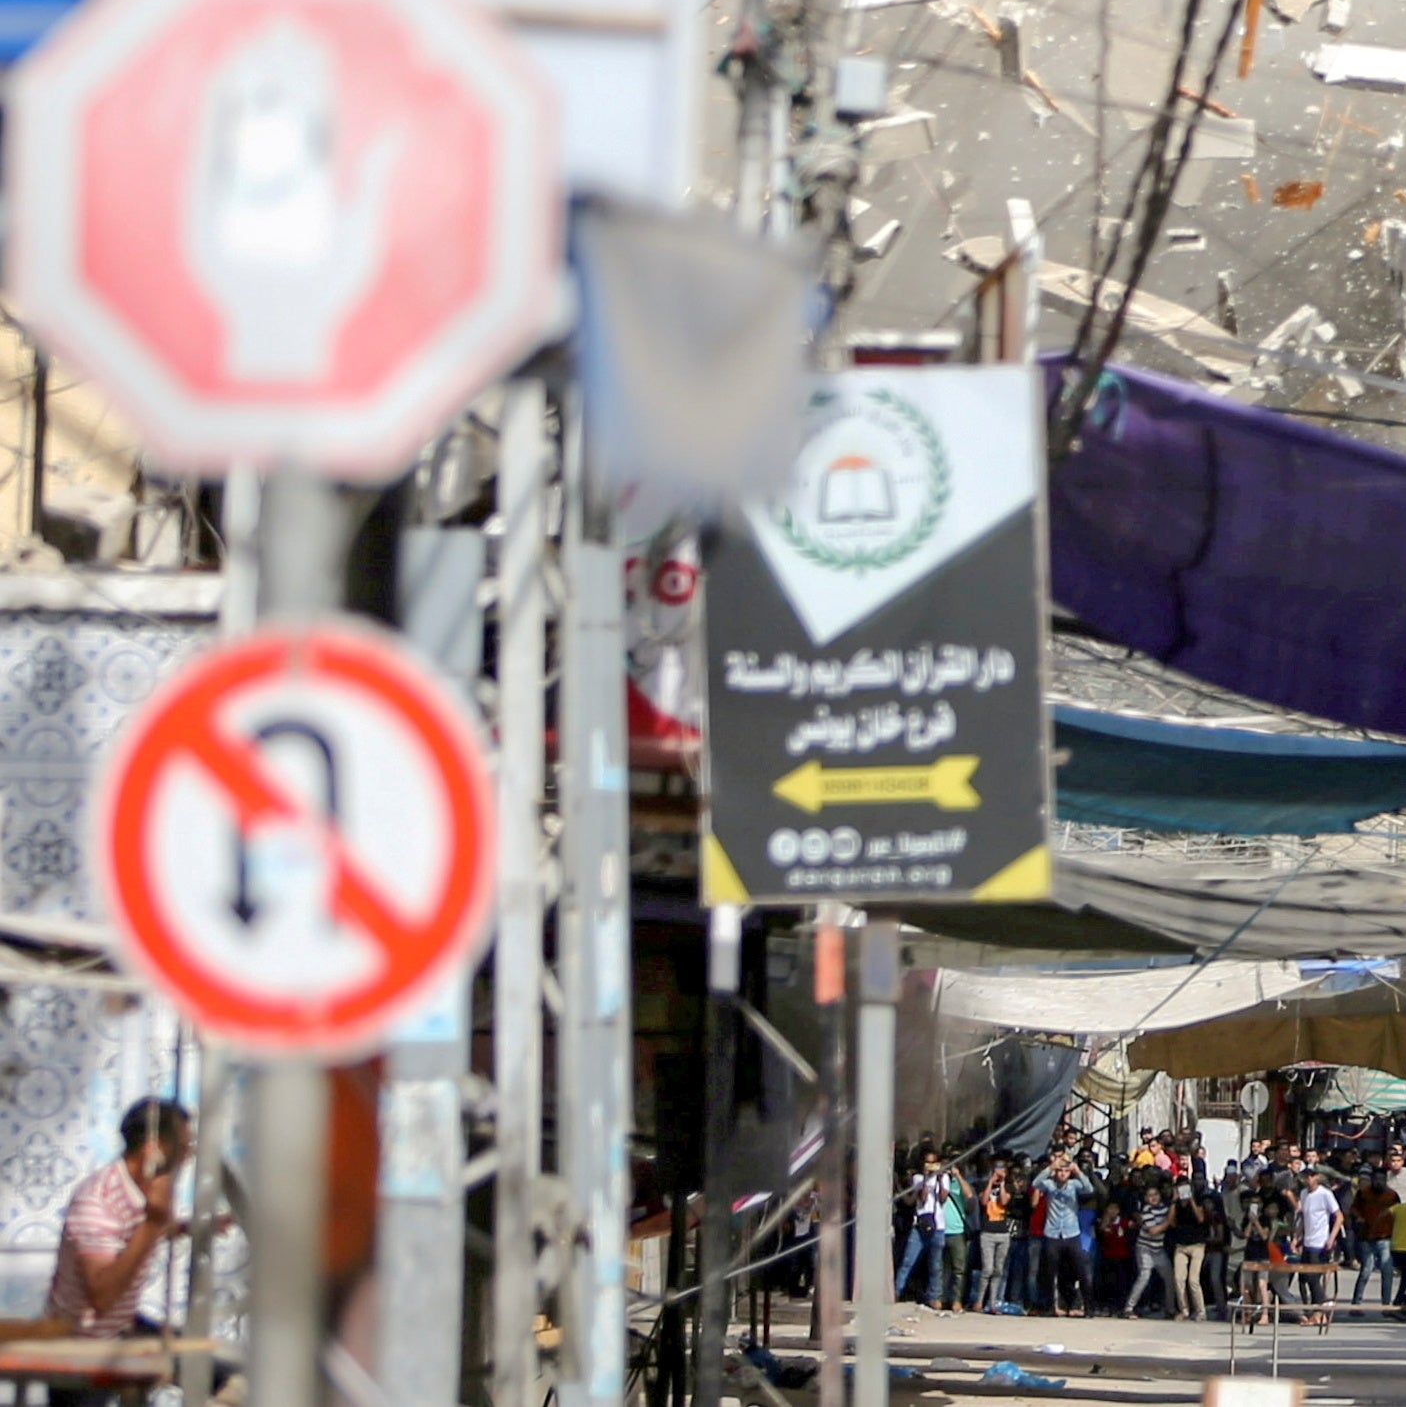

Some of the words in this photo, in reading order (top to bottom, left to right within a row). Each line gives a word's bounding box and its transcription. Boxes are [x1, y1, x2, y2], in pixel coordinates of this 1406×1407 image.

[811, 647, 902, 698] الكريم
[973, 644, 1016, 692] دار
[786, 703, 856, 757] يونس
[856, 700, 904, 753] خان
[904, 699, 958, 753] فرع
